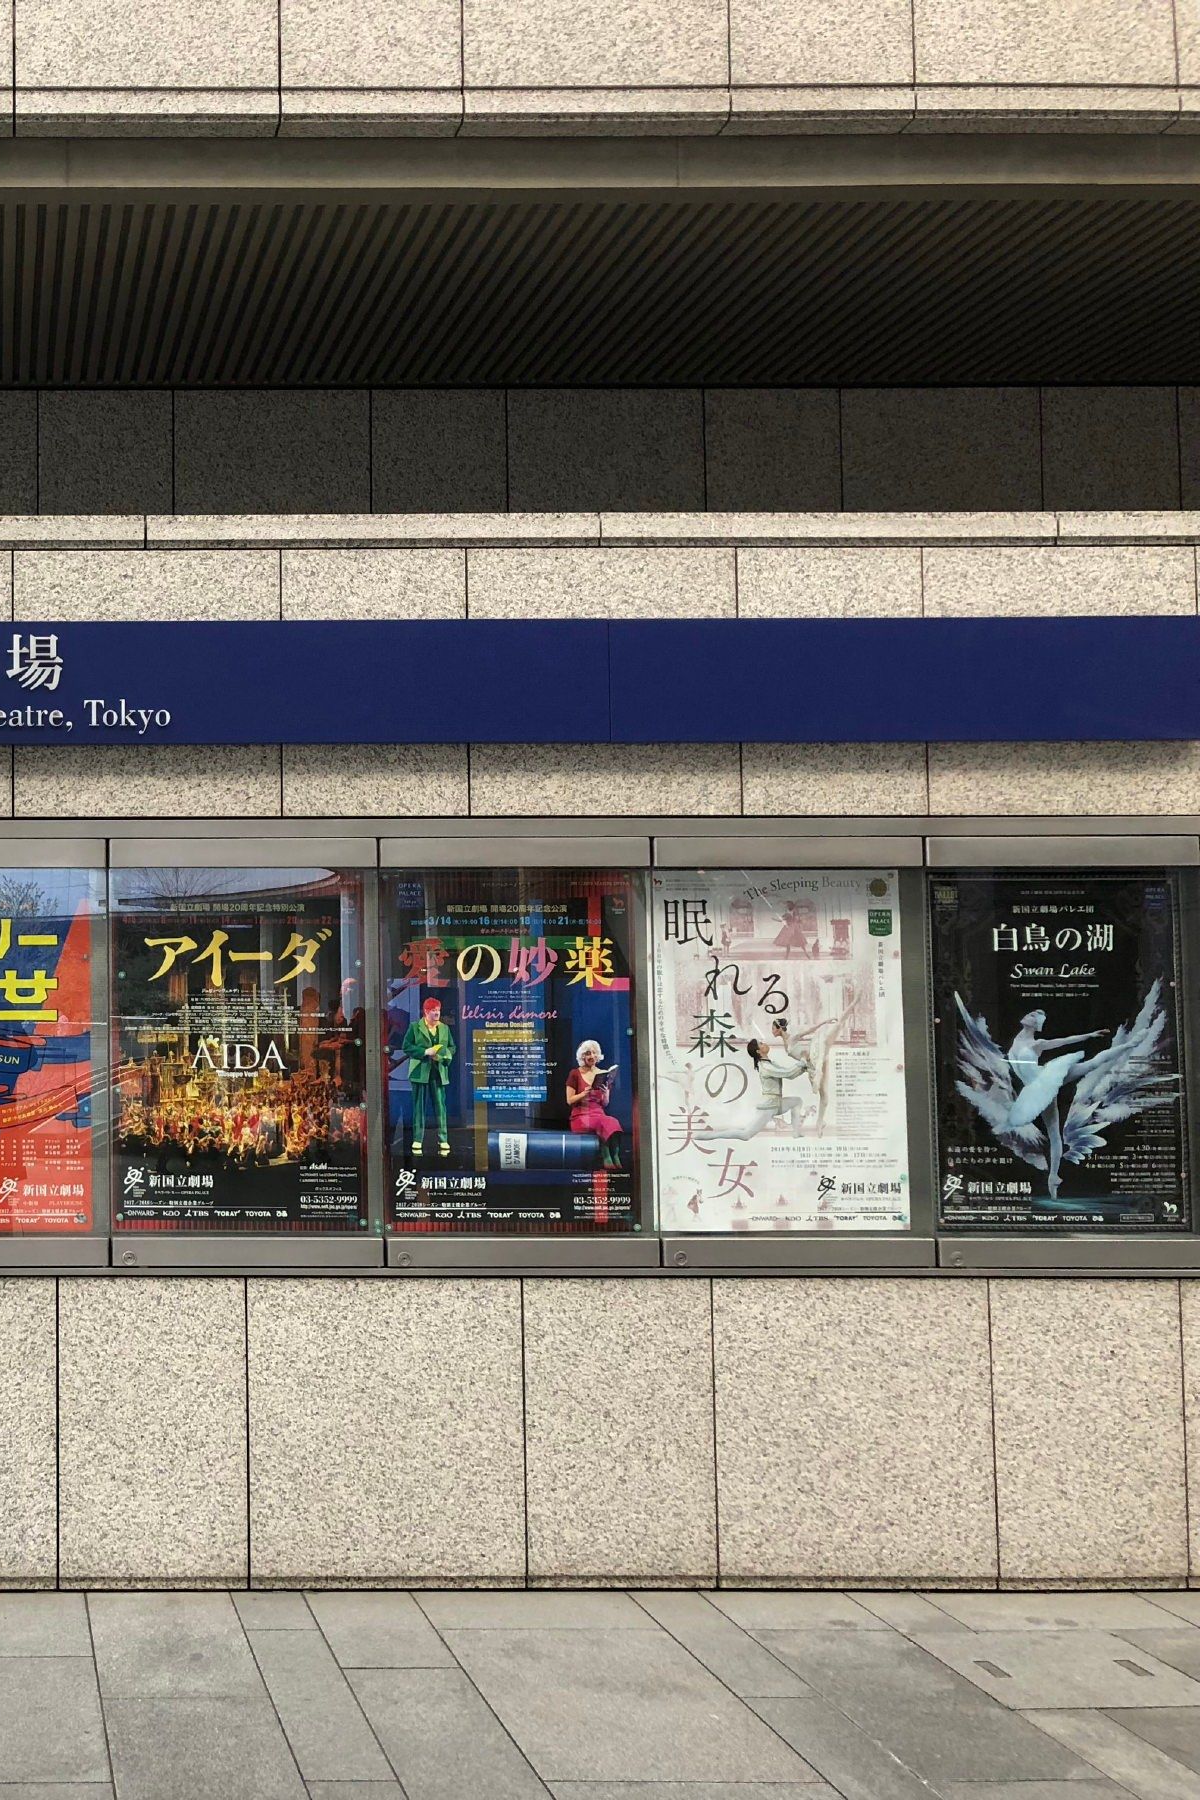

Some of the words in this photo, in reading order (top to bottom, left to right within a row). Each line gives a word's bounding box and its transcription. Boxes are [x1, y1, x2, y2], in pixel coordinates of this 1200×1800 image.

[84, 699, 172, 735] Tokyo
[744, 886, 768, 900] The
[770, 876, 820, 892] Sleeping
[822, 876, 862, 890] Beauty
[446, 904, 488, 912] 新国立劇場
[490, 904, 568, 912] 開場20周年記念公演
[1012, 905, 1094, 914] 新国立劇場バレエ団
[992, 923, 1114, 952] 白鳥の湖
[144, 928, 333, 987] アイーダ
[398, 936, 614, 988] 愛の妙薬
[1010, 963, 1054, 979] Swan
[1058, 963, 1096, 978] Lake
[462, 1004, 504, 1020] L'elisir
[508, 1005, 558, 1020] d'amore
[191, 1040, 289, 1070] AIDA
[149, 1174, 214, 1188] 新国立劇場
[421, 1176, 486, 1190] 新国立劇場
[22, 1184, 84, 1198] 新国立劇場
[841, 1182, 902, 1195] 新国立劇場
[968, 1182, 1032, 1195] 新国立劇場
[300, 1196, 358, 1204] 03-5352-9999
[574, 1196, 630, 1204] 03-5352-9999
